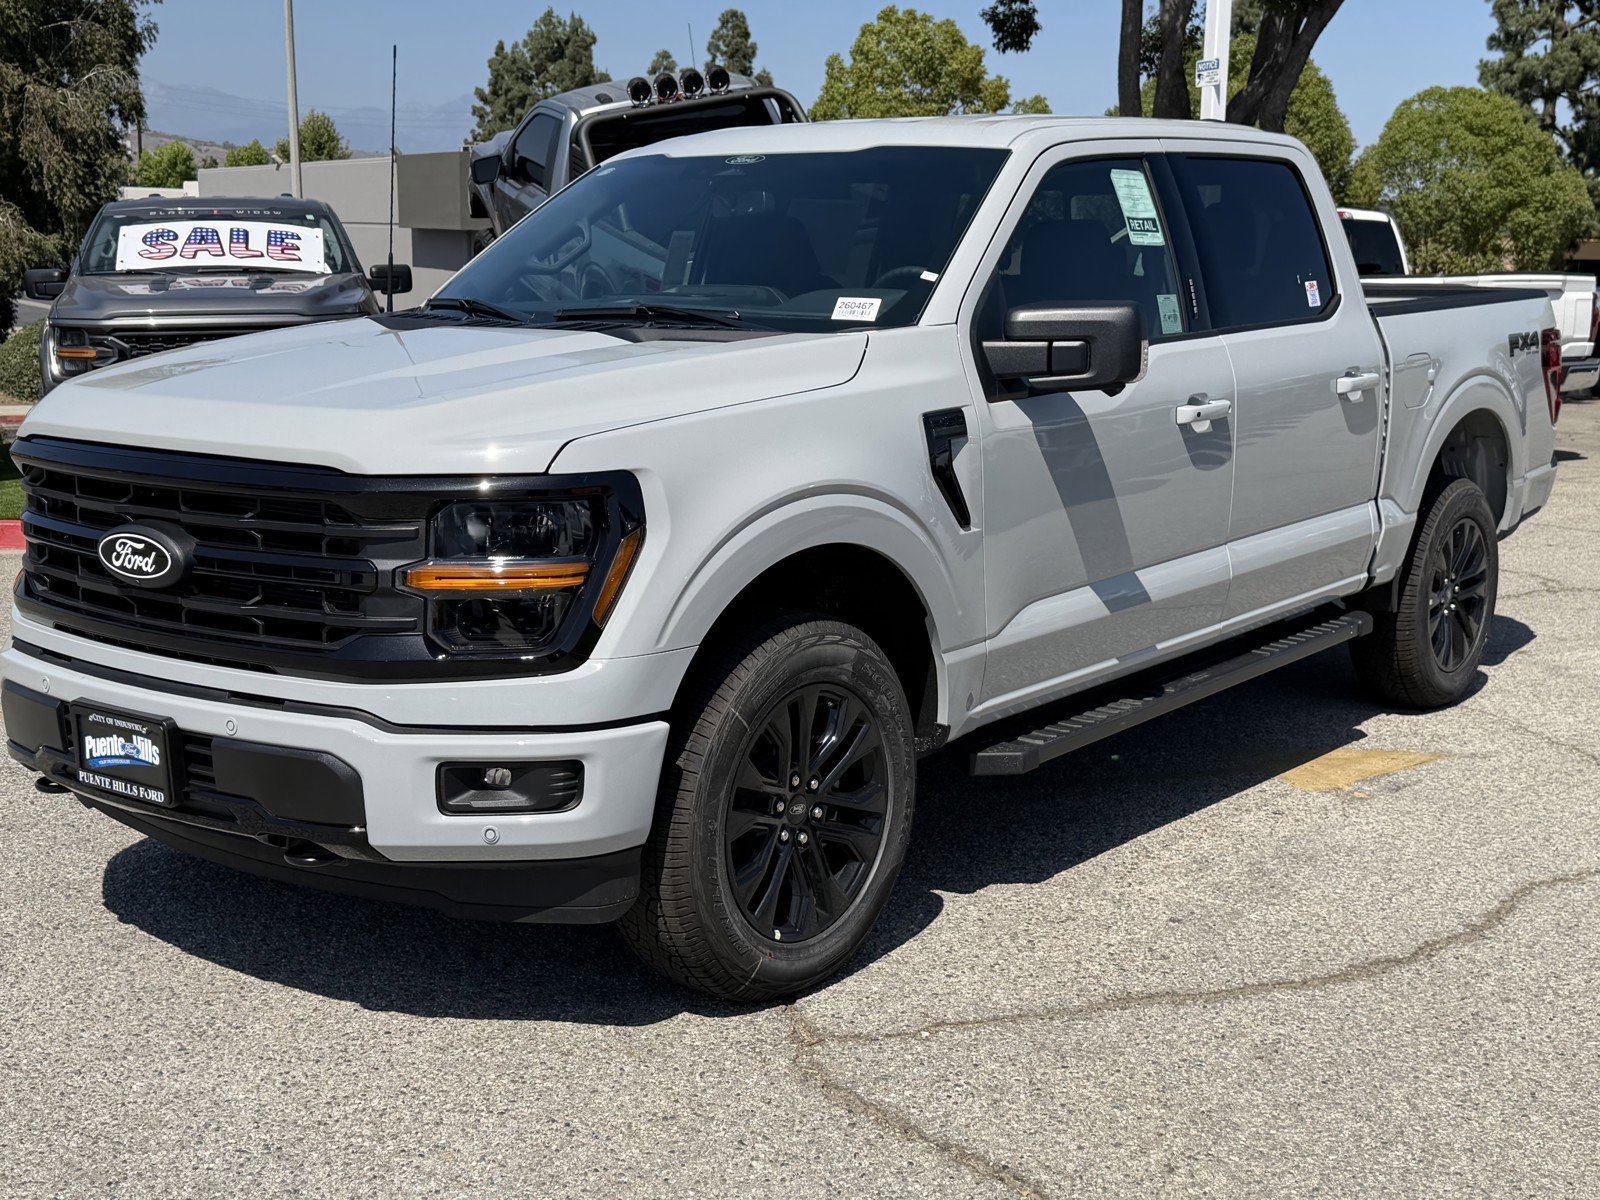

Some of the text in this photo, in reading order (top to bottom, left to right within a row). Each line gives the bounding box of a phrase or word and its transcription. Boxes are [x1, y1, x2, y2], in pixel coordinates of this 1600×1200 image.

[1198, 61, 1218, 71] NOTICE
[1129, 219, 1156, 231] RETAIL
[138, 227, 302, 262] SALE
[838, 301, 874, 310] 260467
[1508, 331, 1539, 357] FX4
[112, 538, 156, 572] Ford
[84, 734, 126, 759] Puente
[79, 770, 164, 803] PUENTE HILLS FORD
